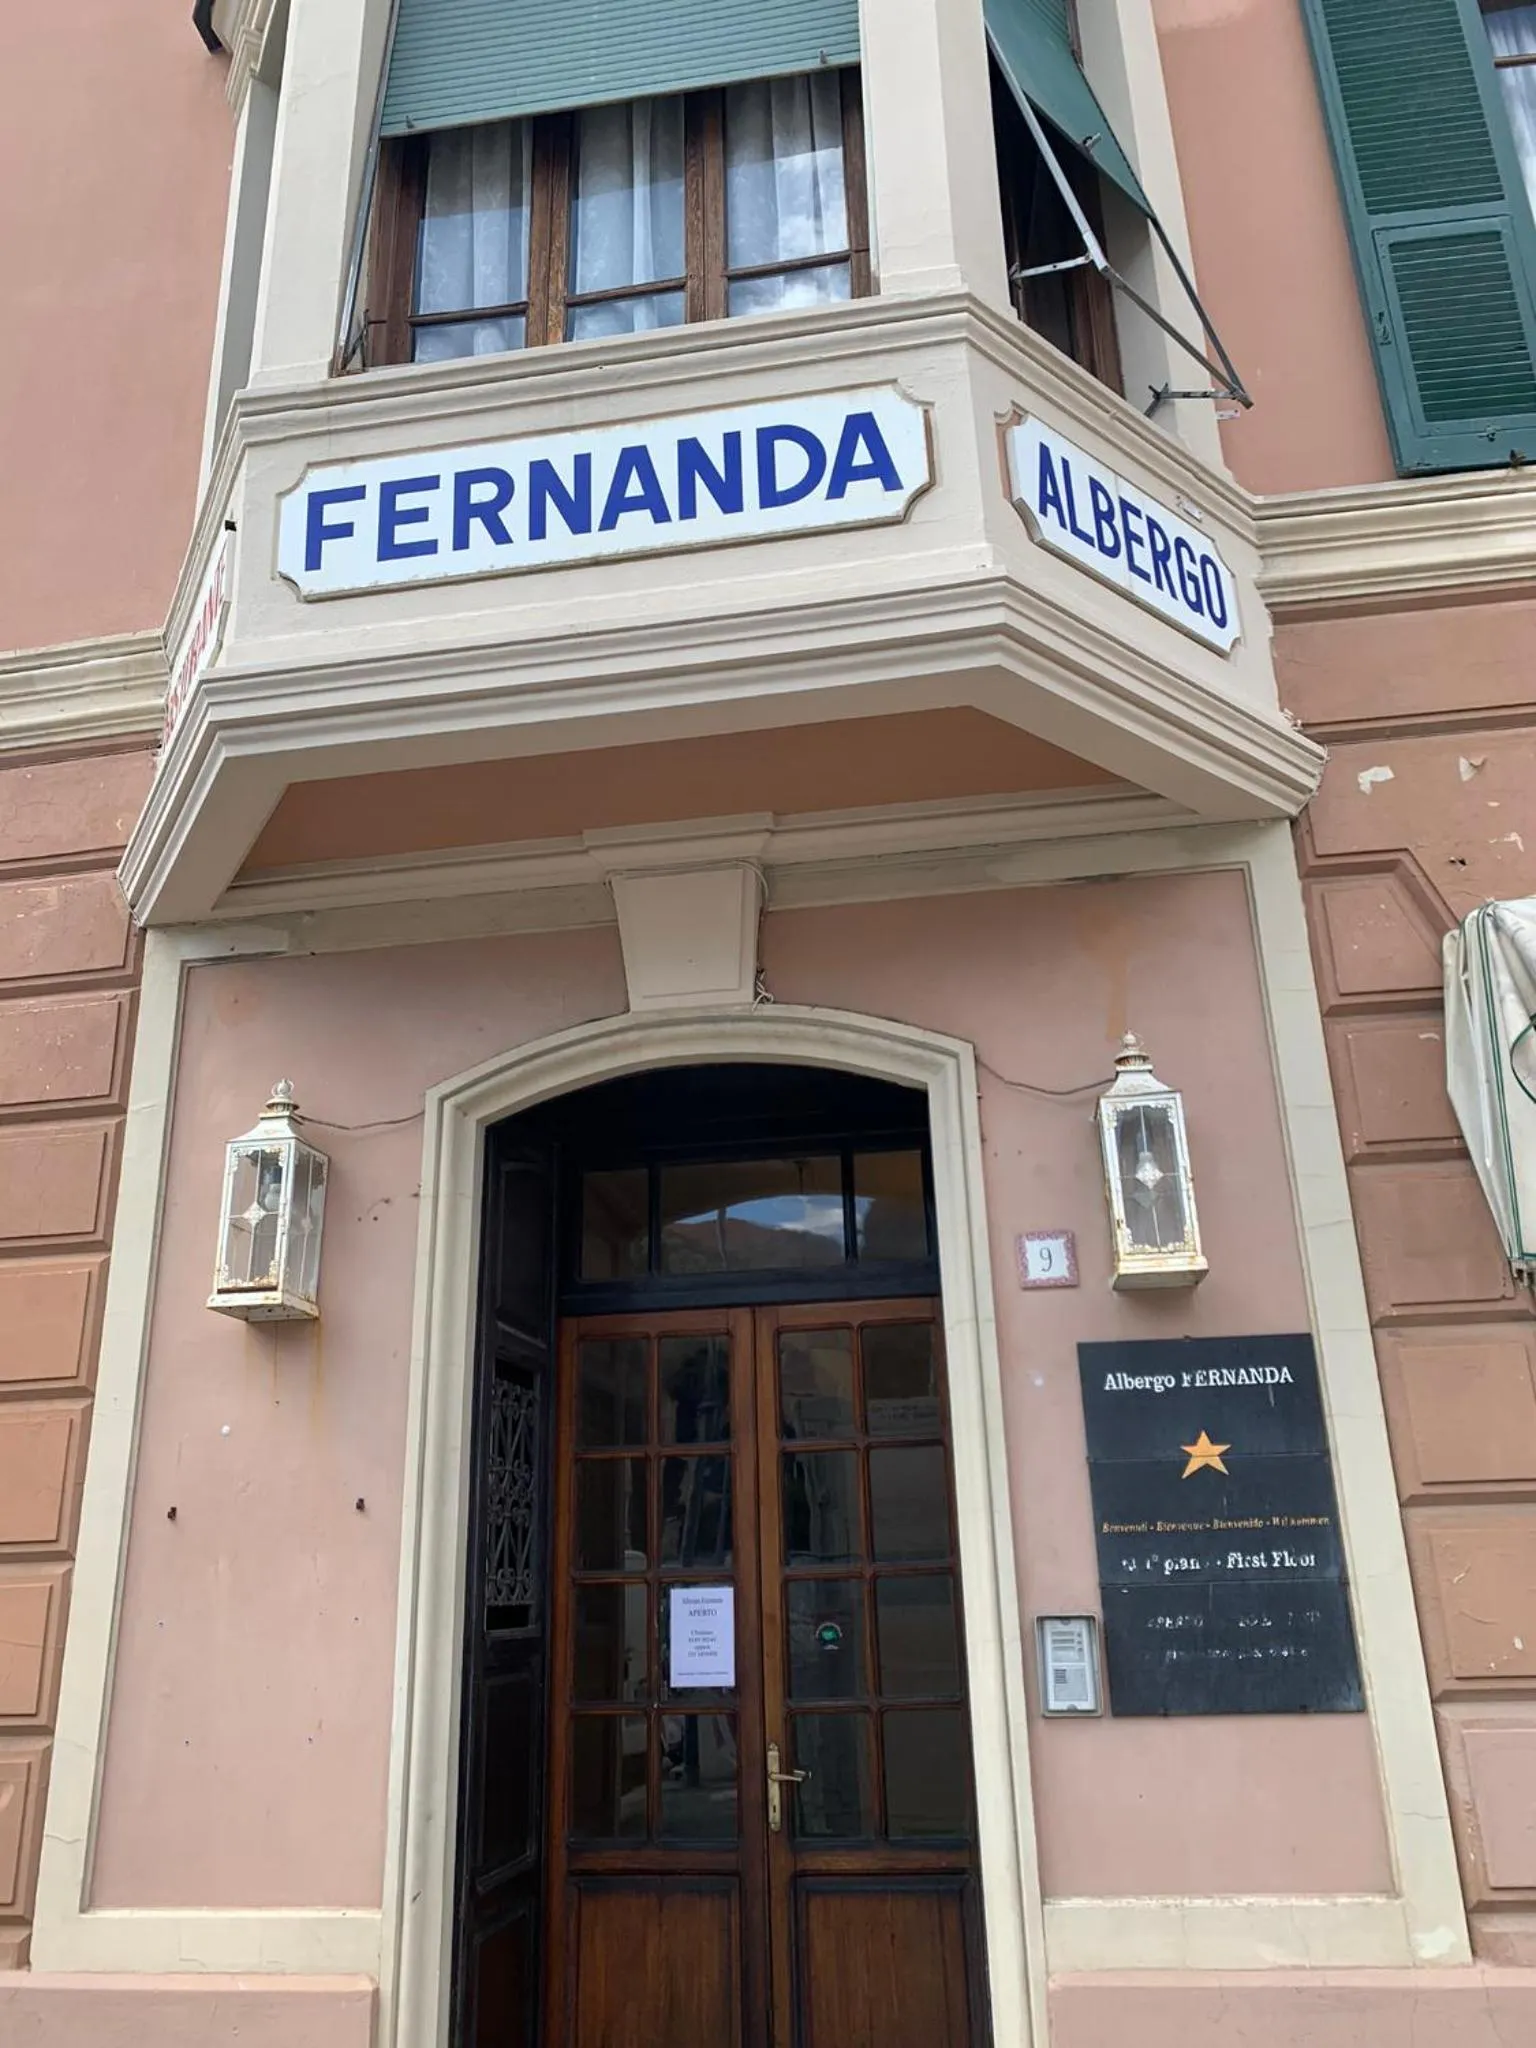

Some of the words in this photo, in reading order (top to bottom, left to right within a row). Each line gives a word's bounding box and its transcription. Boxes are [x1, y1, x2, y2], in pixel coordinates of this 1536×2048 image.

[304, 411, 904, 571] FERNANDA
[1038, 441, 1228, 629] ALBERGO
[1039, 1246, 1053, 1273] 9
[1103, 1372, 1176, 1393] Albergo
[1181, 1366, 1295, 1388] FERNANDA
[1164, 1557, 1210, 1576] pan
